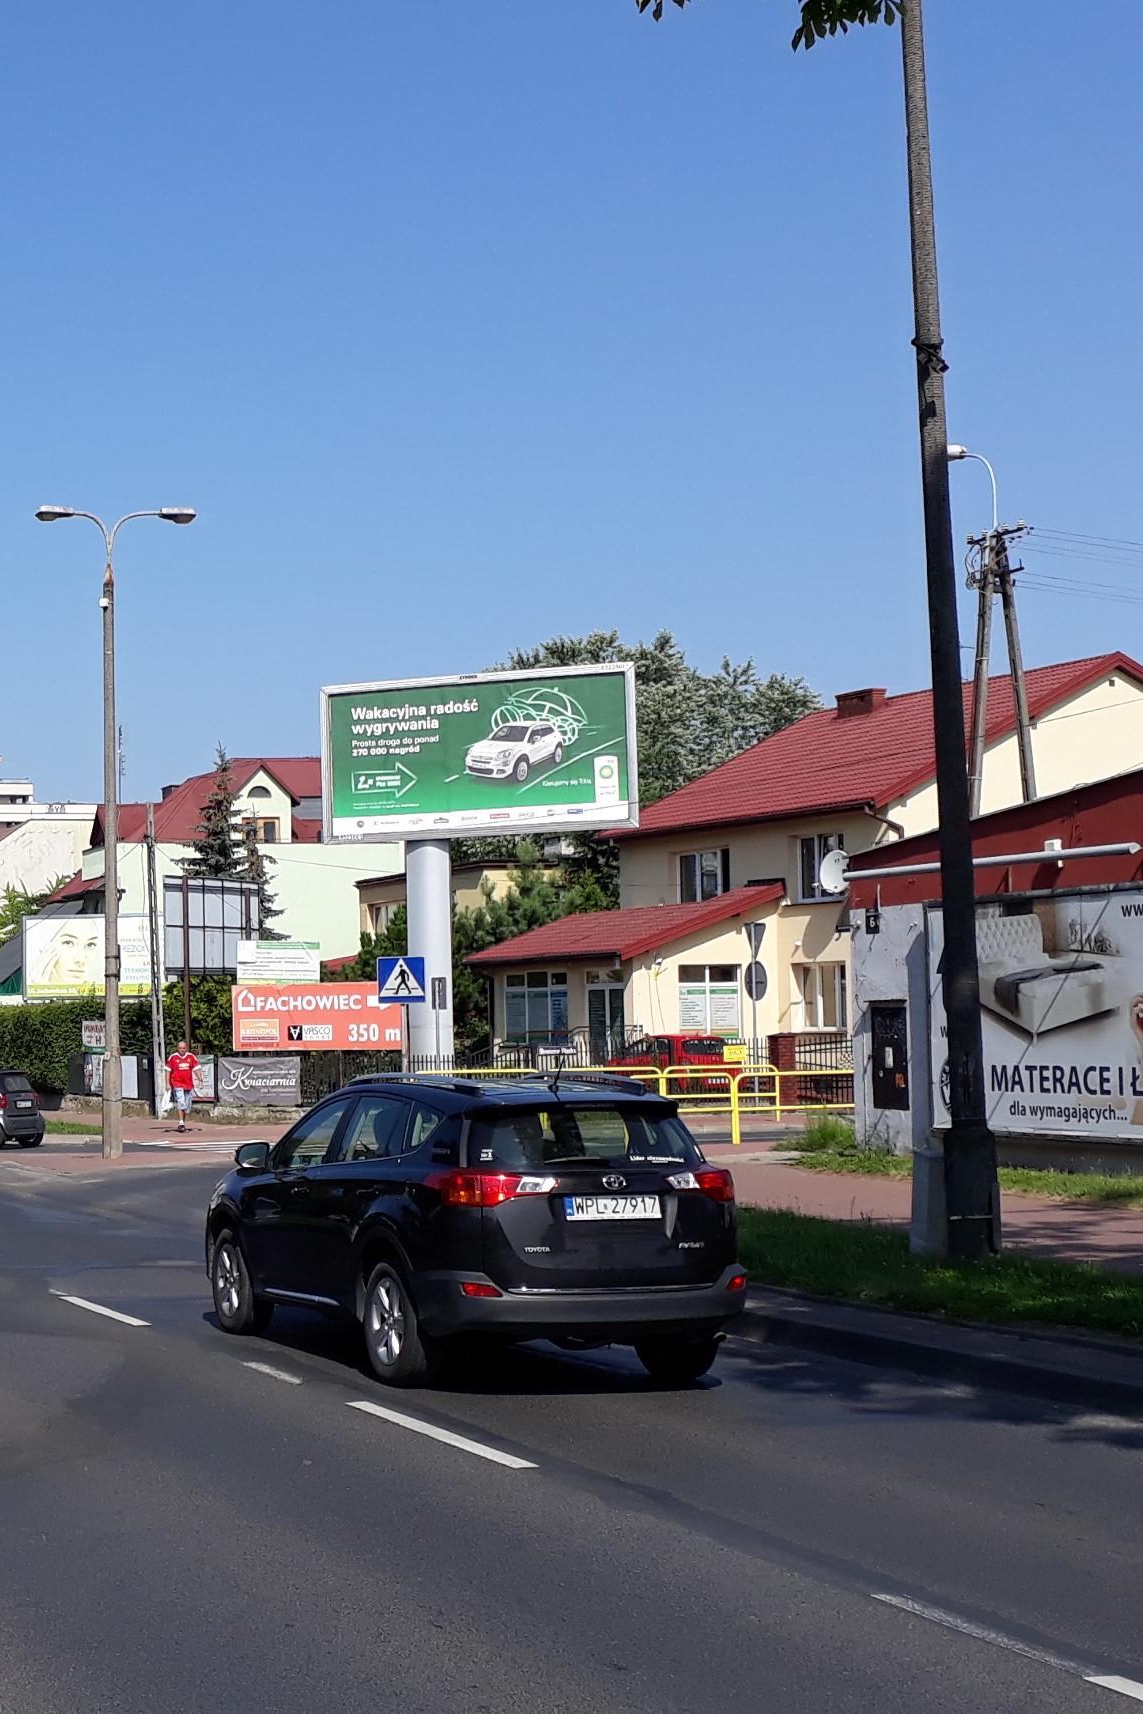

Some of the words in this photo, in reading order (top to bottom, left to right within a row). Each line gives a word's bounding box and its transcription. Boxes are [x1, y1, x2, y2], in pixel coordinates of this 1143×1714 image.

[351, 704, 426, 720] Wakacyjna
[430, 699, 479, 715] radość
[351, 717, 439, 736] wygrywania
[378, 738, 400, 747] droga
[402, 736, 412, 744] do
[415, 734, 439, 744] ponad
[352, 748, 368, 757] 270
[370, 747, 387, 755] 000
[389, 745, 420, 755] nagród
[256, 994, 362, 1011] FACHOWIEC
[304, 1026, 331, 1035] VASCO
[348, 1023, 379, 1042] 350
[384, 1027, 401, 1041] m
[222, 1066, 296, 1090] Kwiaciarnia
[991, 1064, 1112, 1096] MATERACE
[1118, 1066, 1124, 1096] I
[1009, 1100, 1026, 1117] dla
[1029, 1103, 1128, 1124] wymagających...
[575, 1197, 605, 1214] WPL
[611, 1196, 656, 1214] 27917
